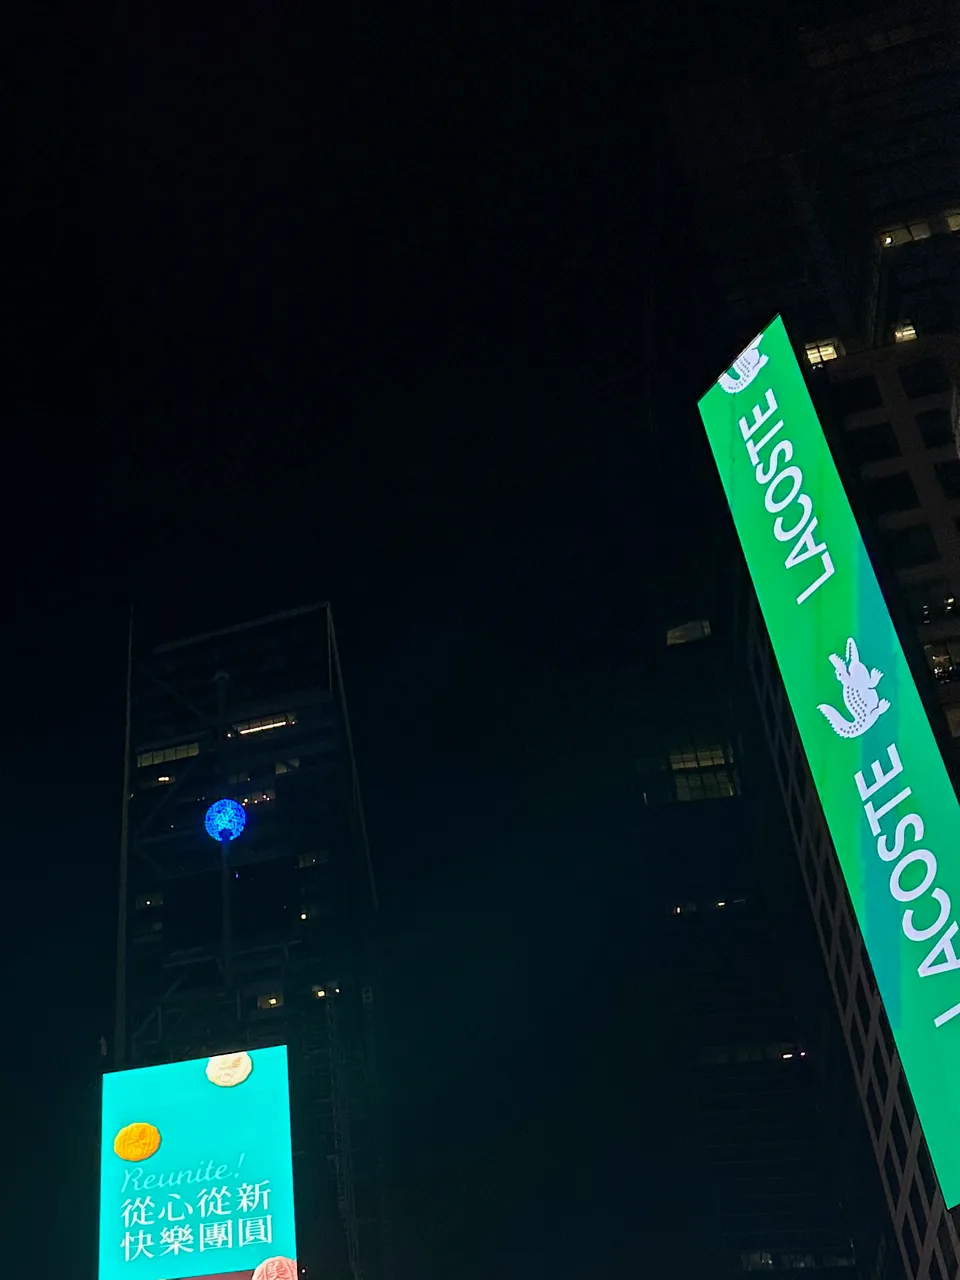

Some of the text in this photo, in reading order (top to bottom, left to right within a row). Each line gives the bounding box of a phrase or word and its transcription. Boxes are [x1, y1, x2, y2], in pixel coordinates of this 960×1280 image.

[738, 388, 835, 604] LACOSTE
[121, 1152, 246, 1192] Reunite!
[120, 1180, 272, 1228] 從心從新
[120, 1214, 273, 1262] 快樂團圓
